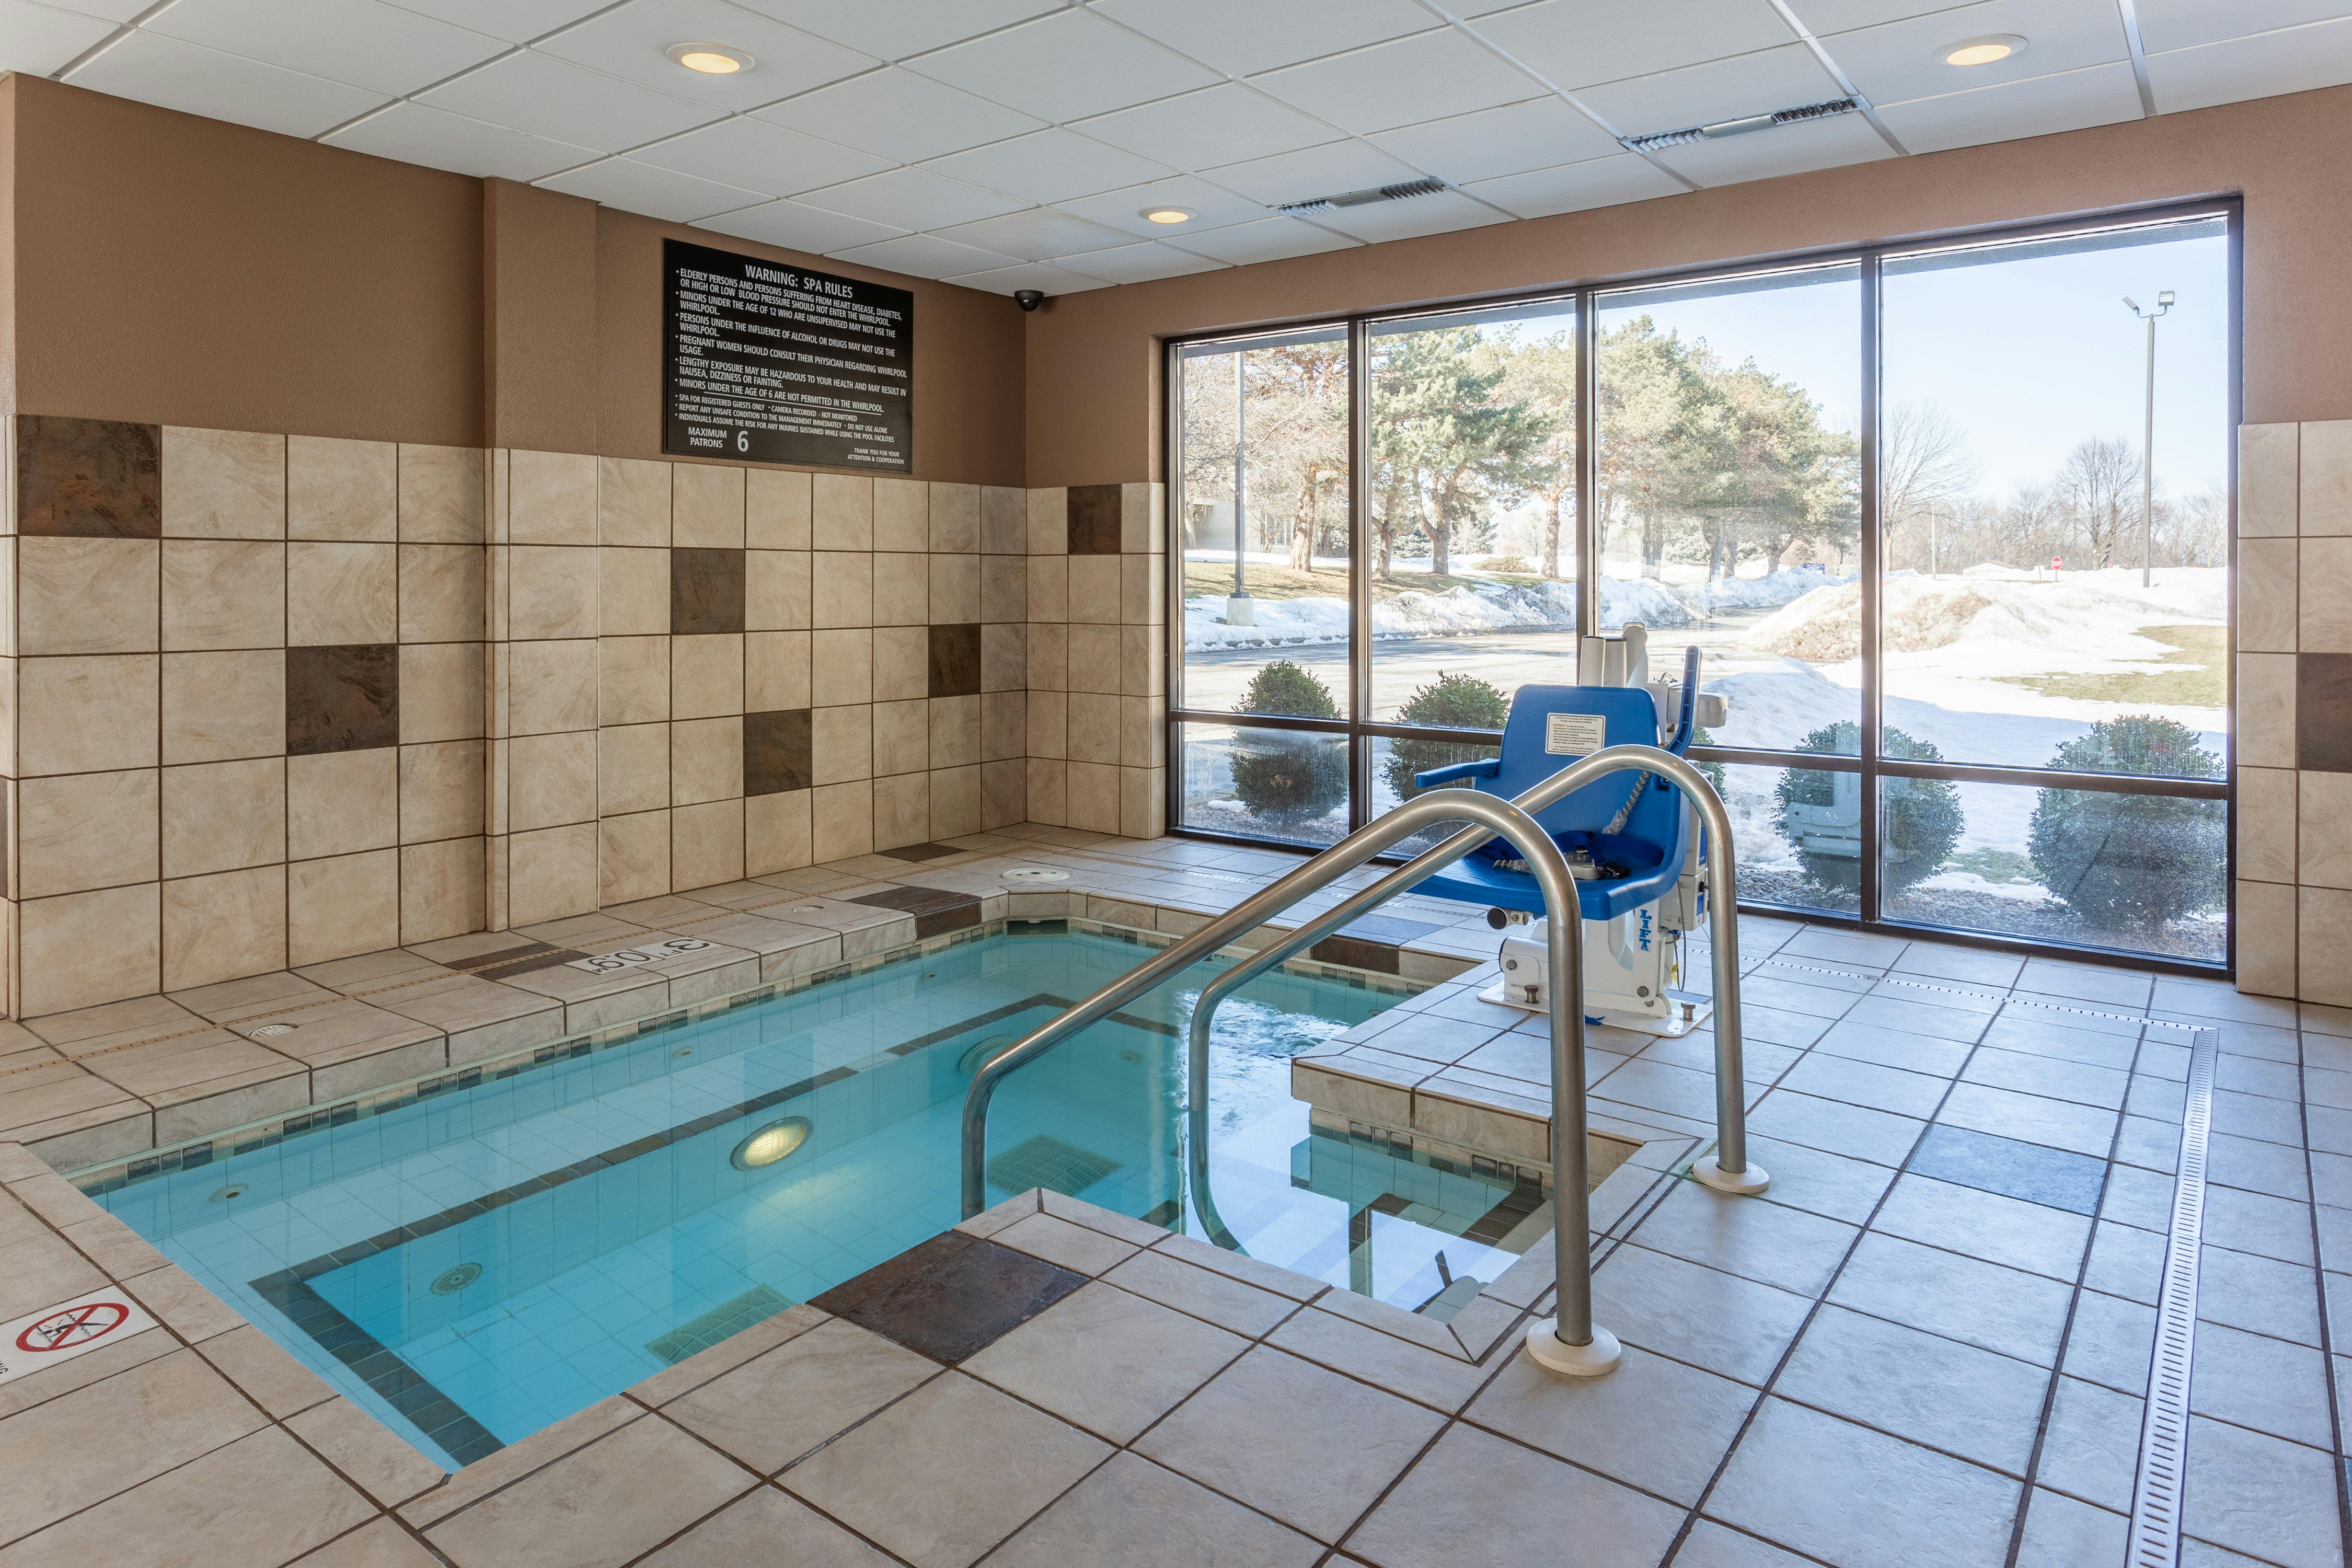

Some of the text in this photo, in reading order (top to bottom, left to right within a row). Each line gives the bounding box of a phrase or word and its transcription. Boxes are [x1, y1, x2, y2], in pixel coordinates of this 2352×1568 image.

[745, 264, 852, 298] WARNING: SPA RULES
[679, 299, 720, 315] WHIRLPOOL.
[680, 278, 891, 327] OR HIGH OR LOW BLOOD PRESSURE SHOULD NOT ENTER THE WHIRLPOOL.
[681, 268, 902, 321] ELDERLY PERSONS AND PERSONS SUFFERING FROM HEART DISEASE, DIABETES,
[680, 290, 896, 338] MINORS UNDER THE AGE OF 12 WHO ARE UNSUPERVISED MAY NOT USE THE
[679, 321, 720, 337] WHIRLPOOL.
[680, 312, 895, 357] PERSONS UNDER THE INFLUENCE OF ALCOHOL OR DRUGS MAY NOT USE THE
[679, 344, 704, 356] USAGE.
[679, 334, 907, 378] PREGNANT WOMEN SHOULD CONSULT THEIR PHYSICIAN REGARDING WHIRLPOOL
[679, 355, 906, 397] LENGTHY EXPOSURE MAY BE HAZARDOUS TO YOUR HEALTH AND MAY RESULT IN
[679, 365, 783, 388] NAUSEA, DIZZINESS OR FAINTING.
[679, 378, 884, 412] MINORS UNDER THE AGE OF 6 ARE NOT PERMITTED IN THE WHIRLPOOL.
[679, 394, 689, 402] SPA
[701, 397, 732, 407] REGISTERED
[732, 400, 751, 409] GUESTS
[771, 405, 792, 414] CAMERA
[792, 408, 816, 417] RECORDED
[832, 413, 858, 422] MONITORED
[679, 403, 699, 412] REPORT
[712, 407, 732, 416] UNSAFE
[733, 410, 760, 419] CONDITION
[778, 415, 812, 425] MANAGEMENT
[813, 419, 842, 428] IMMEDIATELY
[679, 413, 712, 423] INDIVIDUALS
[712, 417, 734, 425] ASSUME
[779, 424, 799, 432] INJURIES
[799, 426, 824, 435] SUSTAINED
[874, 434, 894, 443] FACILITIES
[688, 426, 727, 439] MAXIMUM
[690, 437, 723, 448] PATRONS
[737, 430, 749, 452] 6
[875, 456, 904, 465] COOPERATION
[1640, 909, 1652, 948] LIFT
[663, 939, 710, 951] 3
[587, 952, 651, 968] 0.9
